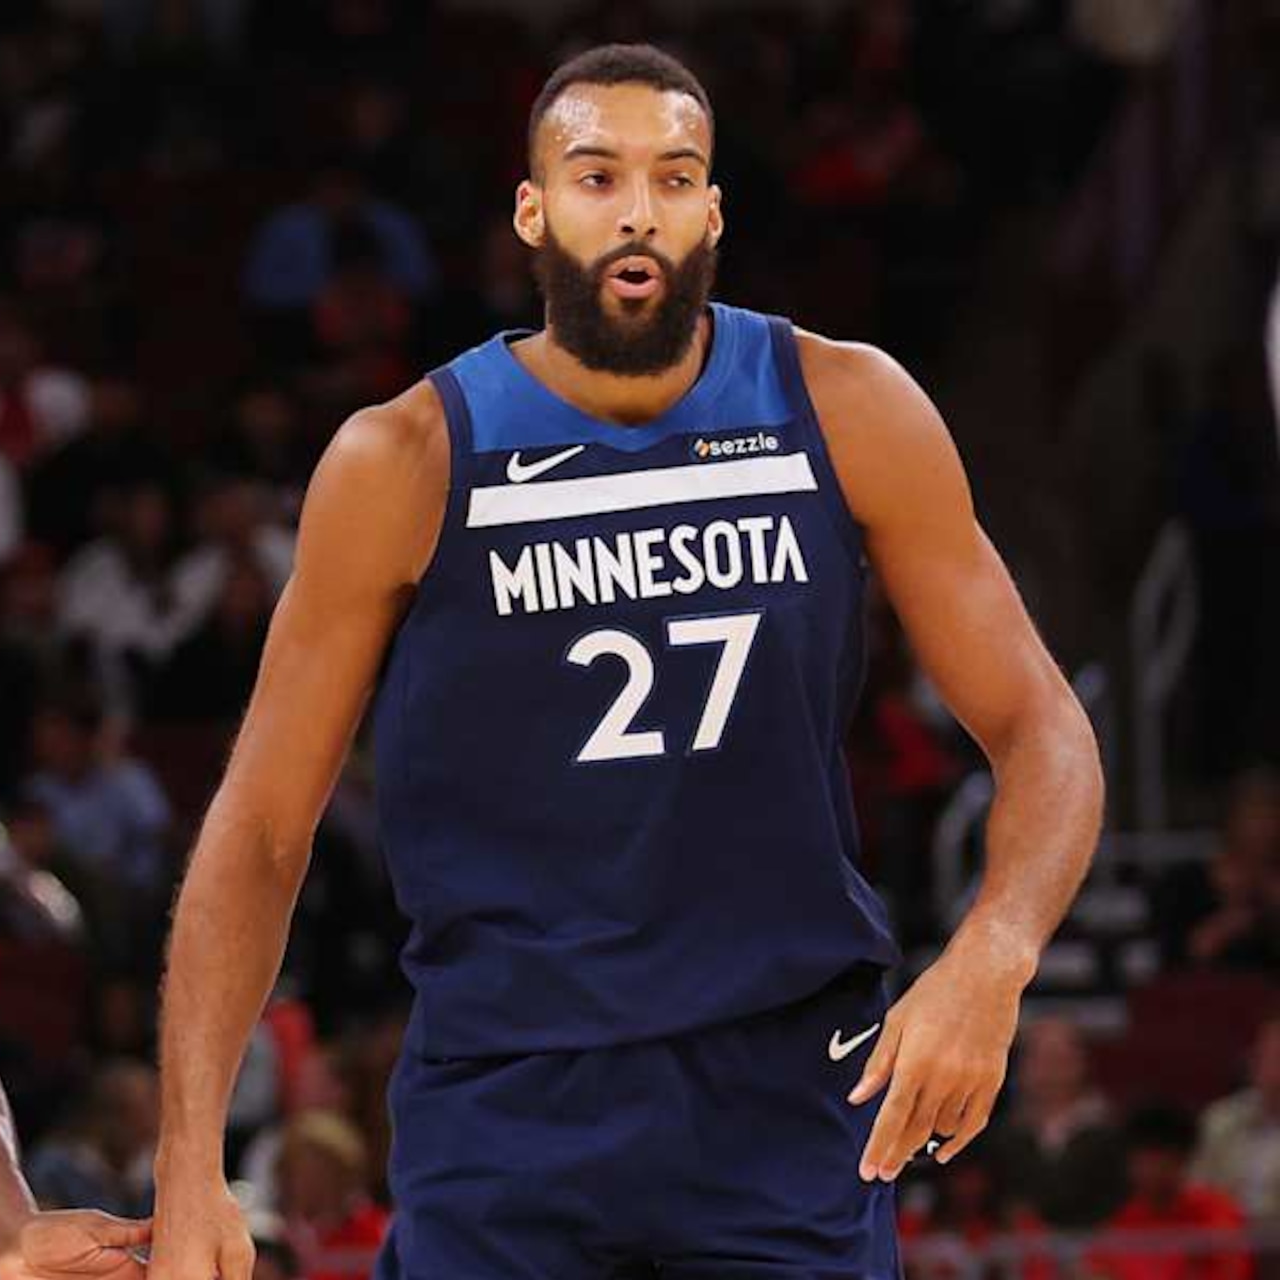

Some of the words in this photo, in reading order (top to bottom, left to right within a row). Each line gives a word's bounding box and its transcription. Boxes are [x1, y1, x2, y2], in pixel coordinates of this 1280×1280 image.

[710, 432, 779, 456] sezzle
[489, 515, 809, 616] MINNESOTA
[566, 612, 762, 763] 27
